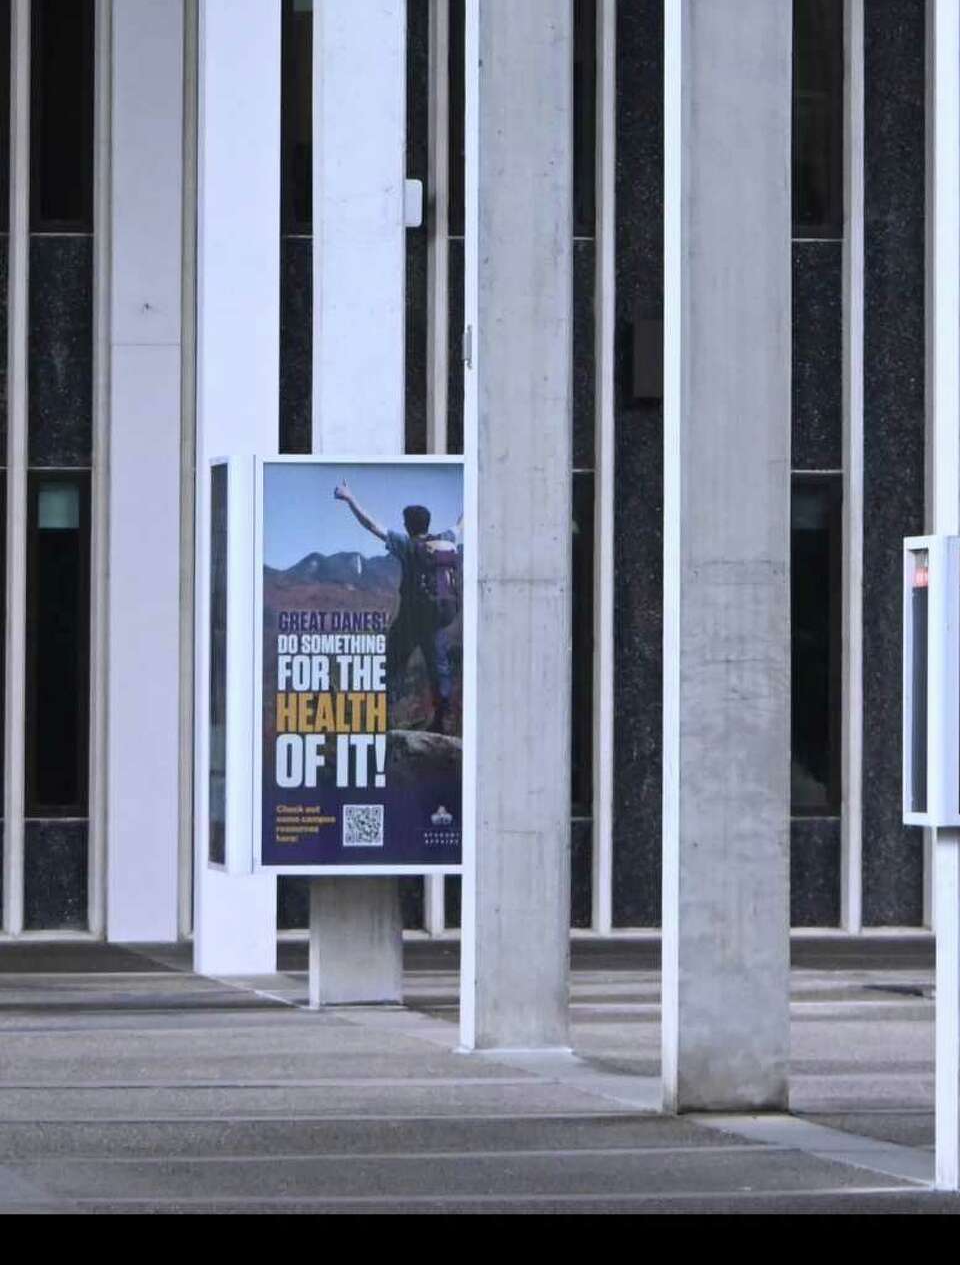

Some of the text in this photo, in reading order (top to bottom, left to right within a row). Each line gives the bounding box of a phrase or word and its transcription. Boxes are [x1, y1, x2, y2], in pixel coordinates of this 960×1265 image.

[279, 611, 386, 632] GREAT DANES!
[278, 634, 386, 654] DO SOMETHING
[278, 655, 386, 691] FOR THE
[276, 692, 387, 732] HEALTH
[276, 733, 386, 787] OF IT!
